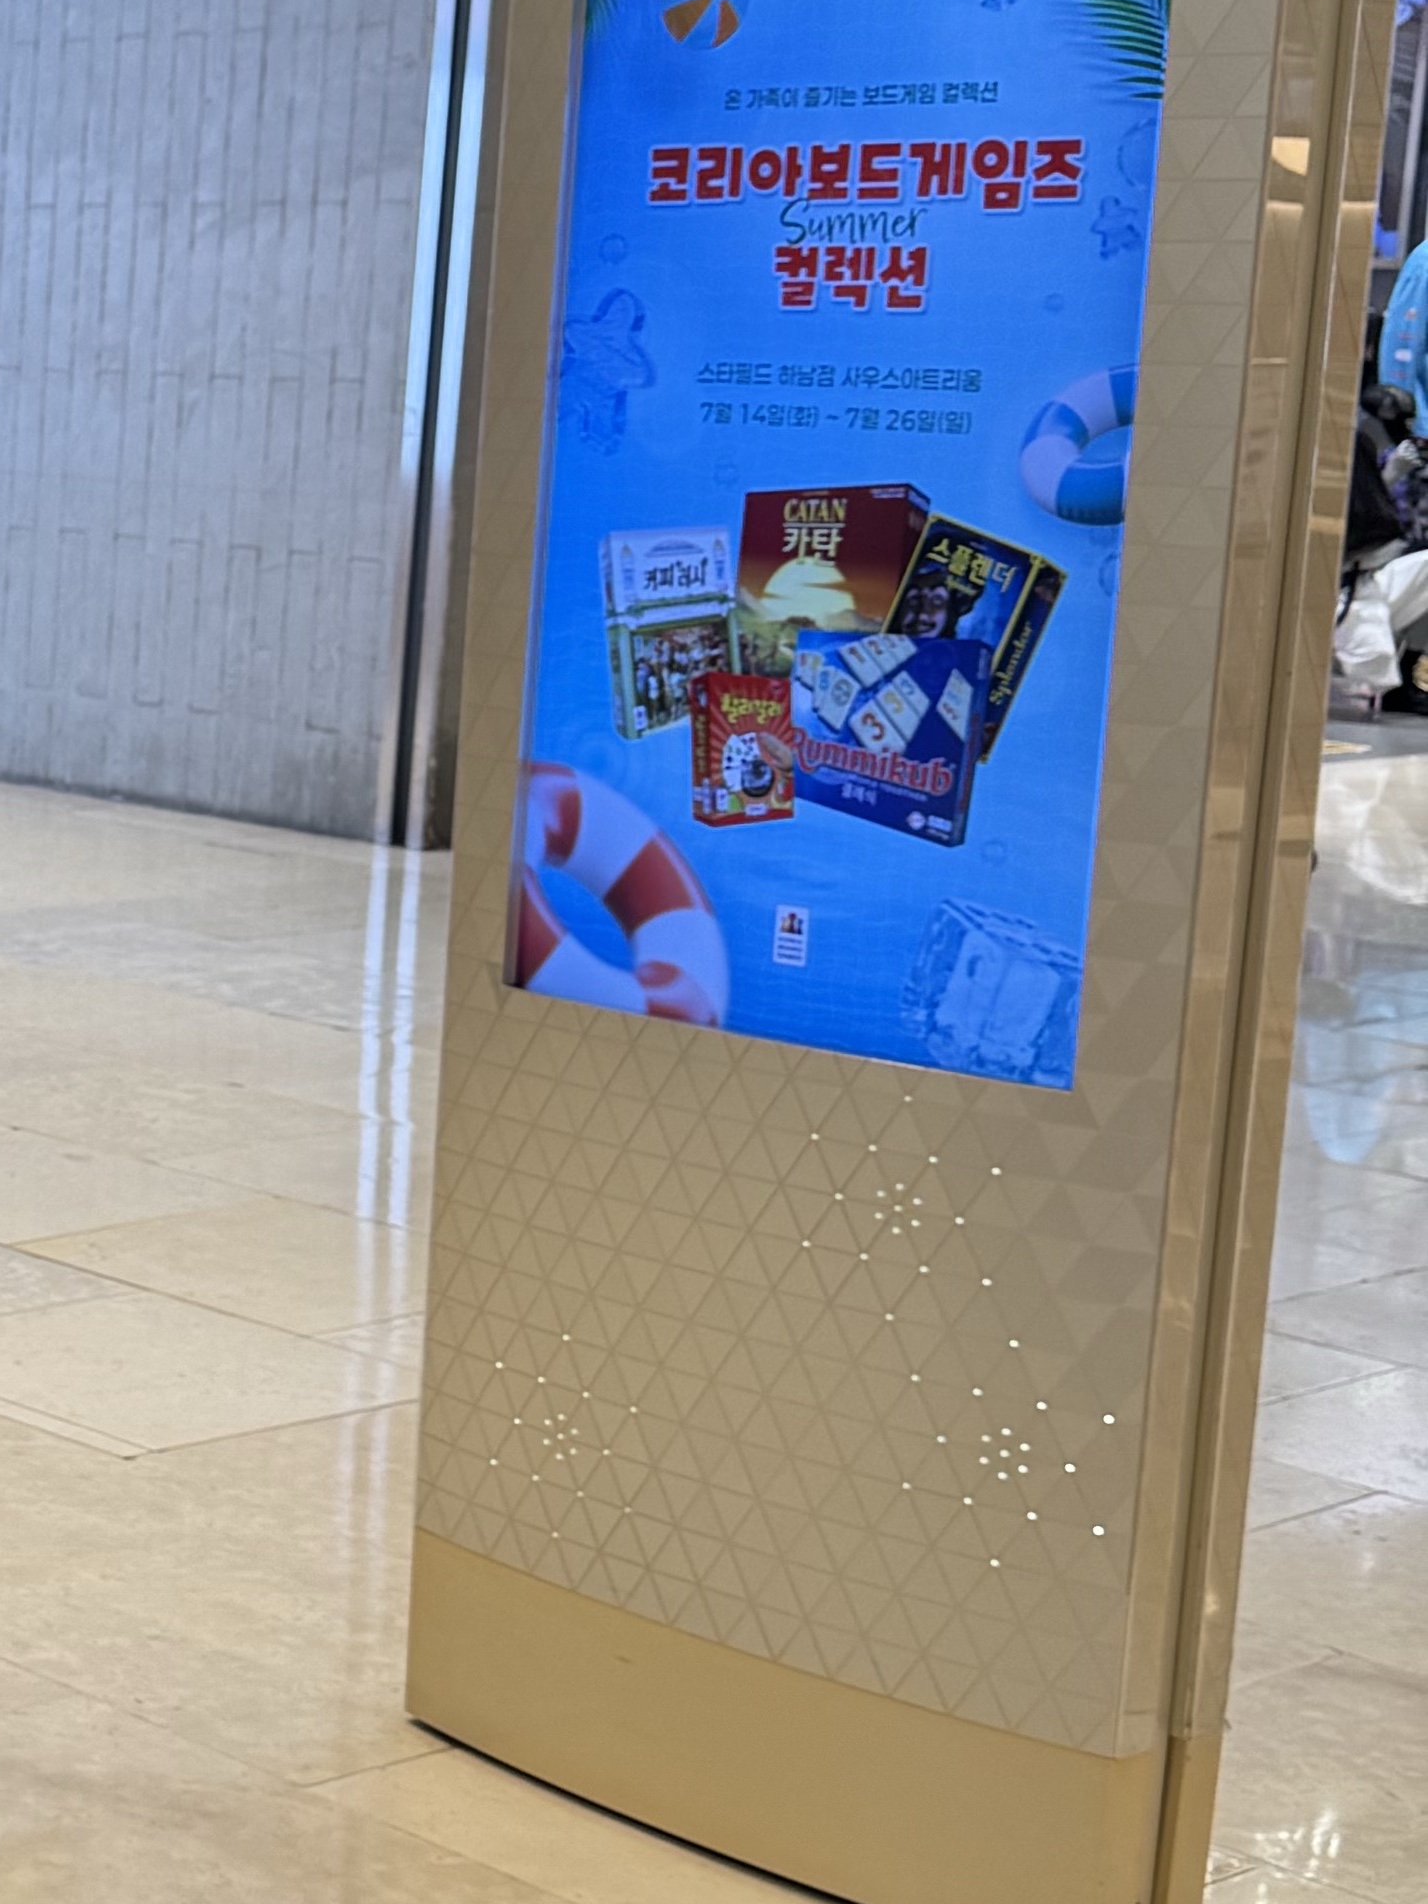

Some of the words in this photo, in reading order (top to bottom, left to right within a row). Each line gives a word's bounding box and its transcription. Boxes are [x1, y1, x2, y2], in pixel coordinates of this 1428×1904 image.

[862, 83, 936, 106] 보드게임
[942, 81, 998, 104] 컬렉션
[648, 139, 1083, 210] 코리아보드게임즈
[778, 197, 928, 245] Summer
[773, 246, 928, 309] 컬렉션
[696, 362, 772, 386] 스타필드
[778, 364, 836, 388] 하남점
[841, 366, 983, 394] 사우스아트리움
[700, 401, 732, 425] 7월
[846, 407, 880, 431] 7월
[783, 498, 848, 523] CATAN
[782, 526, 844, 568] 카탄
[861, 712, 886, 742] 3
[792, 727, 954, 796] Rummikub
